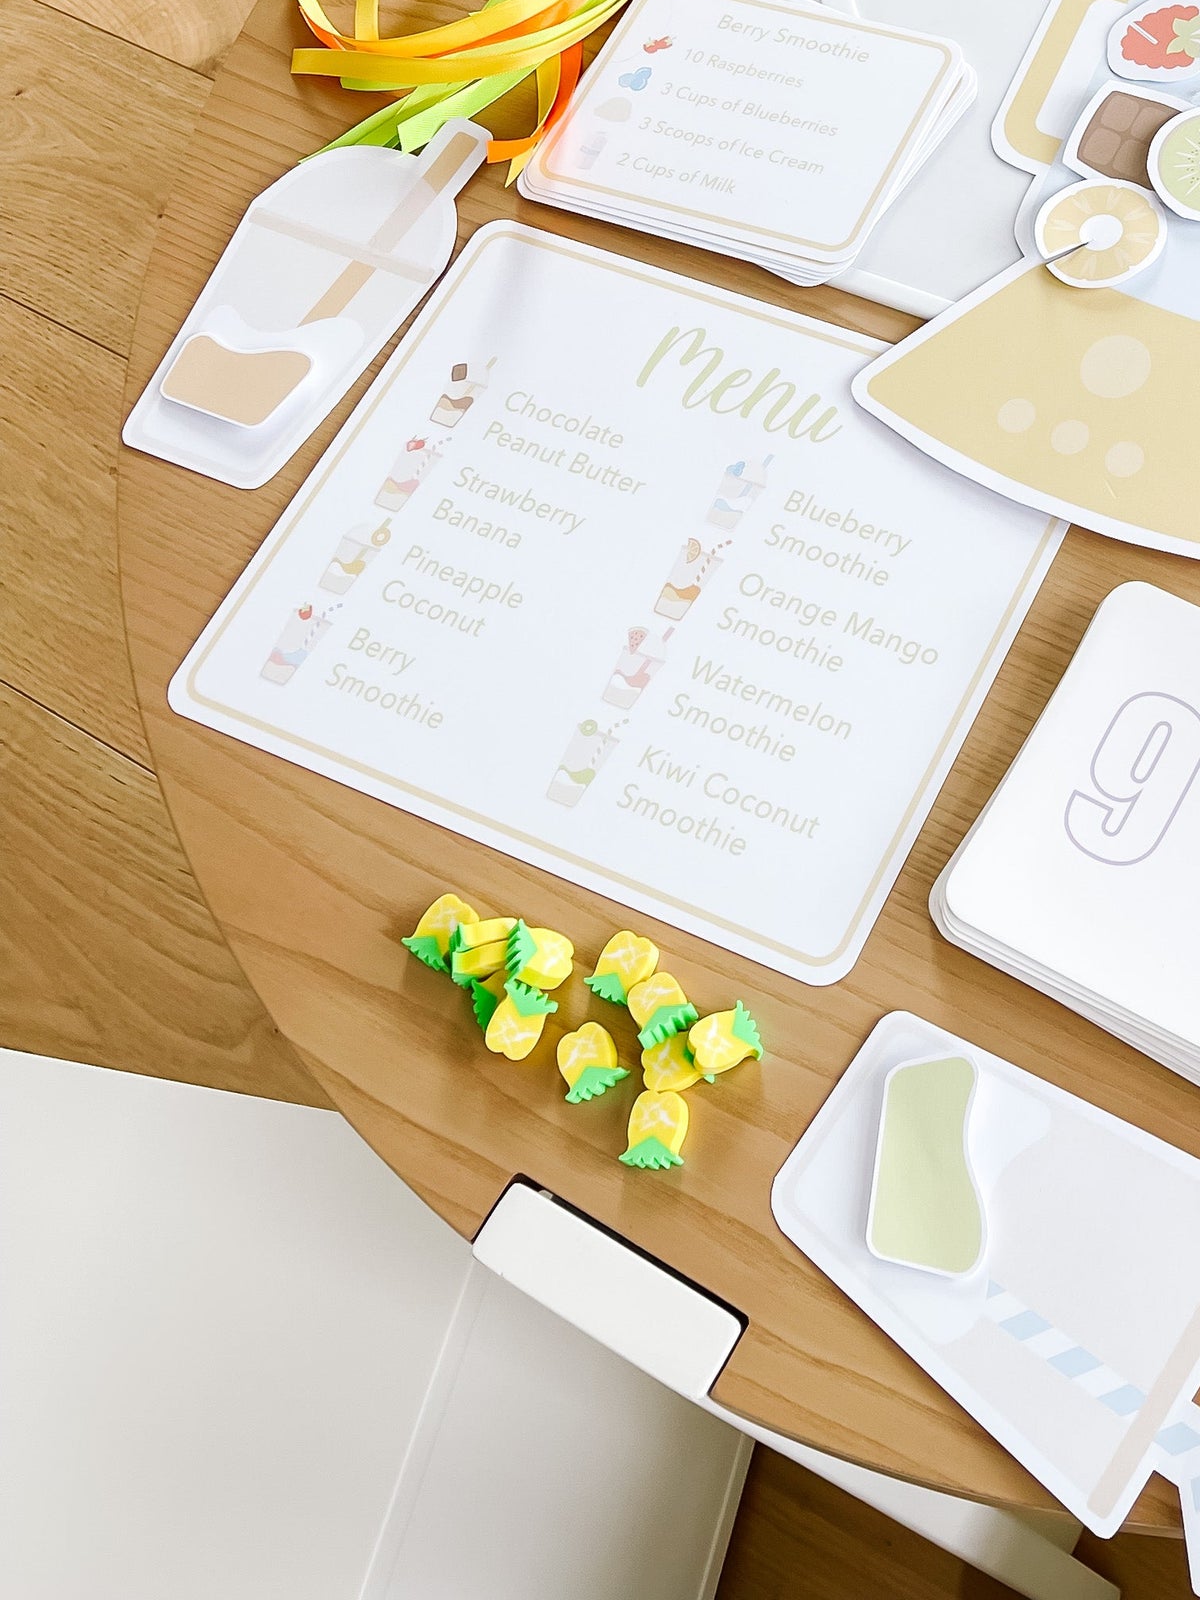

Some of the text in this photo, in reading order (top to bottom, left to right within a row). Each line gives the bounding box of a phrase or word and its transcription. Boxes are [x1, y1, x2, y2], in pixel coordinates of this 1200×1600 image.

[684, 47, 804, 89] 10 Raspberries
[717, 14, 870, 64] Berry Smoothie
[660, 81, 838, 137] 3 Cups of Blueberries
[616, 152, 737, 196] 2 Cups of Milk
[639, 116, 825, 175] 3 Scoops of Ice Cream
[636, 326, 844, 445] Menu
[504, 391, 625, 450] Chocolate
[482, 420, 647, 497] Peanut Butter
[432, 498, 523, 550] Banana
[453, 466, 587, 536] Strawberry
[783, 490, 913, 558] Blueberry
[401, 545, 524, 611] Pineapple
[764, 524, 891, 588] Smoothie
[381, 580, 487, 639] Coconut
[716, 606, 844, 675] Smoothie
[738, 572, 939, 668] Orange Mango
[347, 627, 416, 677] Berry
[324, 663, 444, 730] Smoothie
[667, 693, 797, 764] Smoothie
[690, 655, 853, 742] Watermelon
[616, 783, 748, 858] Smoothie
[637, 744, 821, 842] Kiwi Coconut
